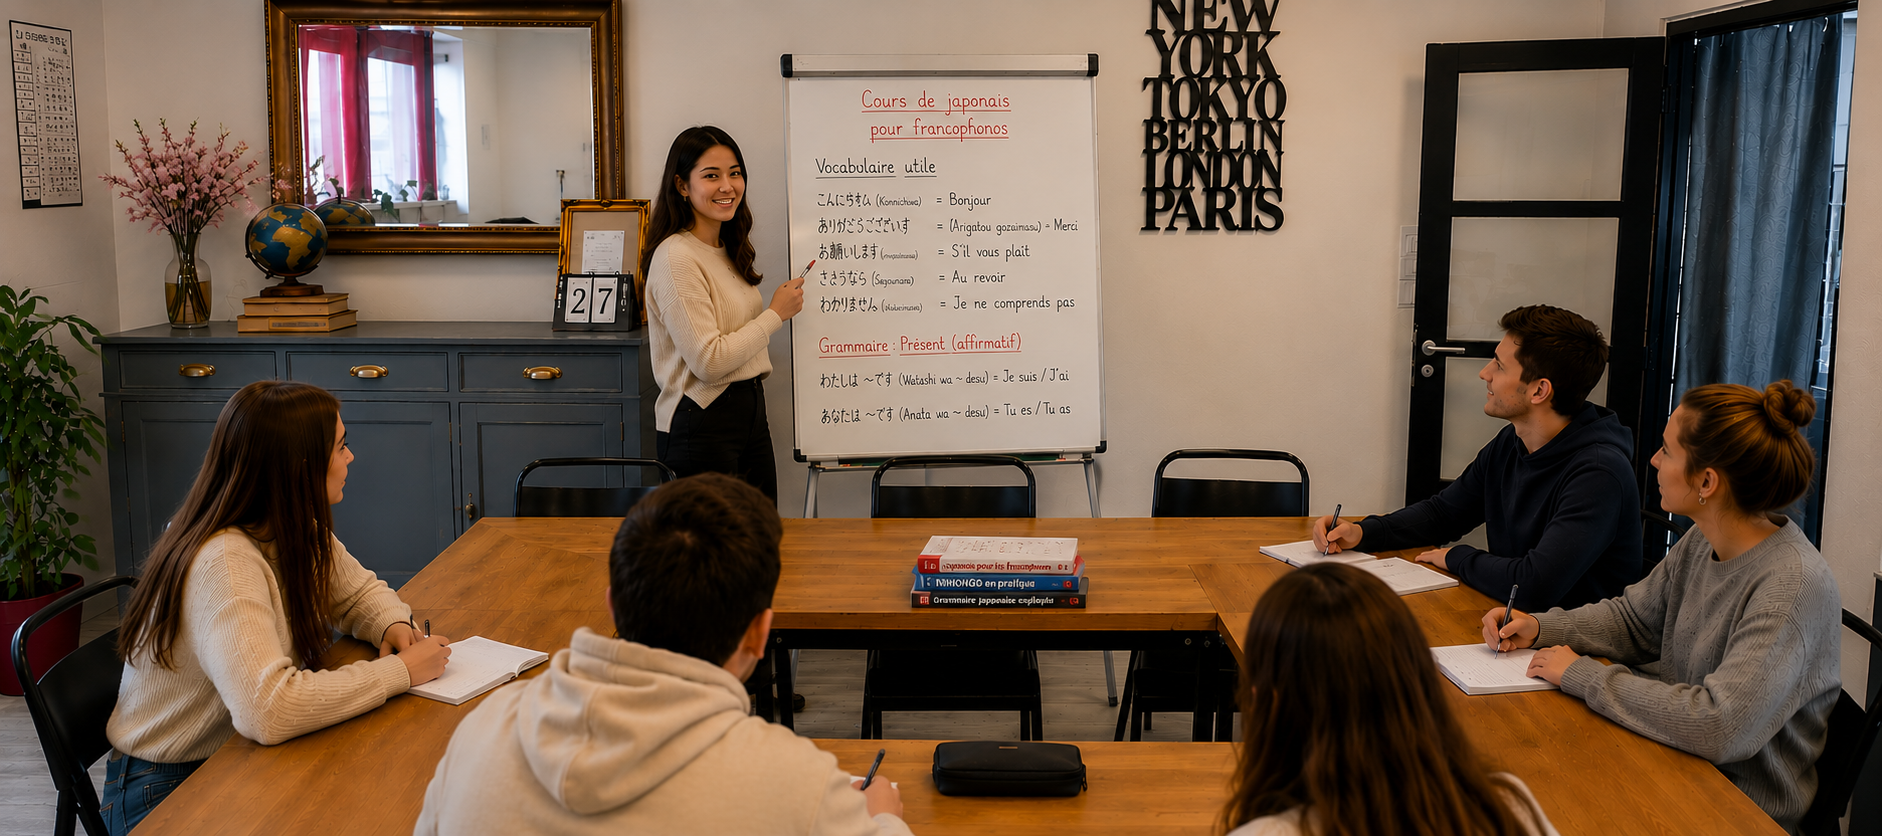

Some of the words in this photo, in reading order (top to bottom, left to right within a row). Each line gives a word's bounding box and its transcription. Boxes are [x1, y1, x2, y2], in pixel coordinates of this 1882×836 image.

[1147, 0, 1280, 34] NEW
[1145, 30, 1281, 78] YORK
[861, 89, 907, 109] Cours
[918, 90, 935, 108] de
[945, 93, 1010, 116] japonais
[1142, 76, 1286, 120] TOKYO
[870, 123, 903, 143] pour
[914, 117, 1008, 142] francophonos
[1142, 119, 1285, 153] BERLIN
[815, 158, 895, 174] Vocabulaire
[904, 157, 936, 173] utile
[1142, 149, 1284, 191] LONDON
[950, 192, 991, 211] Bonjour
[1141, 186, 1284, 231] PARIS
[950, 218, 991, 236] (Arigatou
[1054, 218, 1078, 231] Merci
[977, 249, 999, 258] vous
[952, 270, 967, 283] Au
[975, 272, 1005, 283] revoir
[953, 295, 967, 309] Je
[975, 301, 987, 309] ne
[994, 295, 1051, 313] comprends
[1057, 299, 1075, 312] pas
[819, 337, 888, 354] Grammaire
[952, 333, 1022, 352] (affirmatif)
[966, 371, 989, 385] desu)
[1003, 370, 1015, 383] Je
[1019, 371, 1037, 382] suis
[900, 407, 931, 422] (Anata
[936, 411, 949, 419] wa
[965, 405, 989, 419] desu)
[1004, 403, 1016, 415] Tu
[1021, 407, 1032, 415] es
[1043, 402, 1055, 414] Tu
[1060, 406, 1071, 415] as
